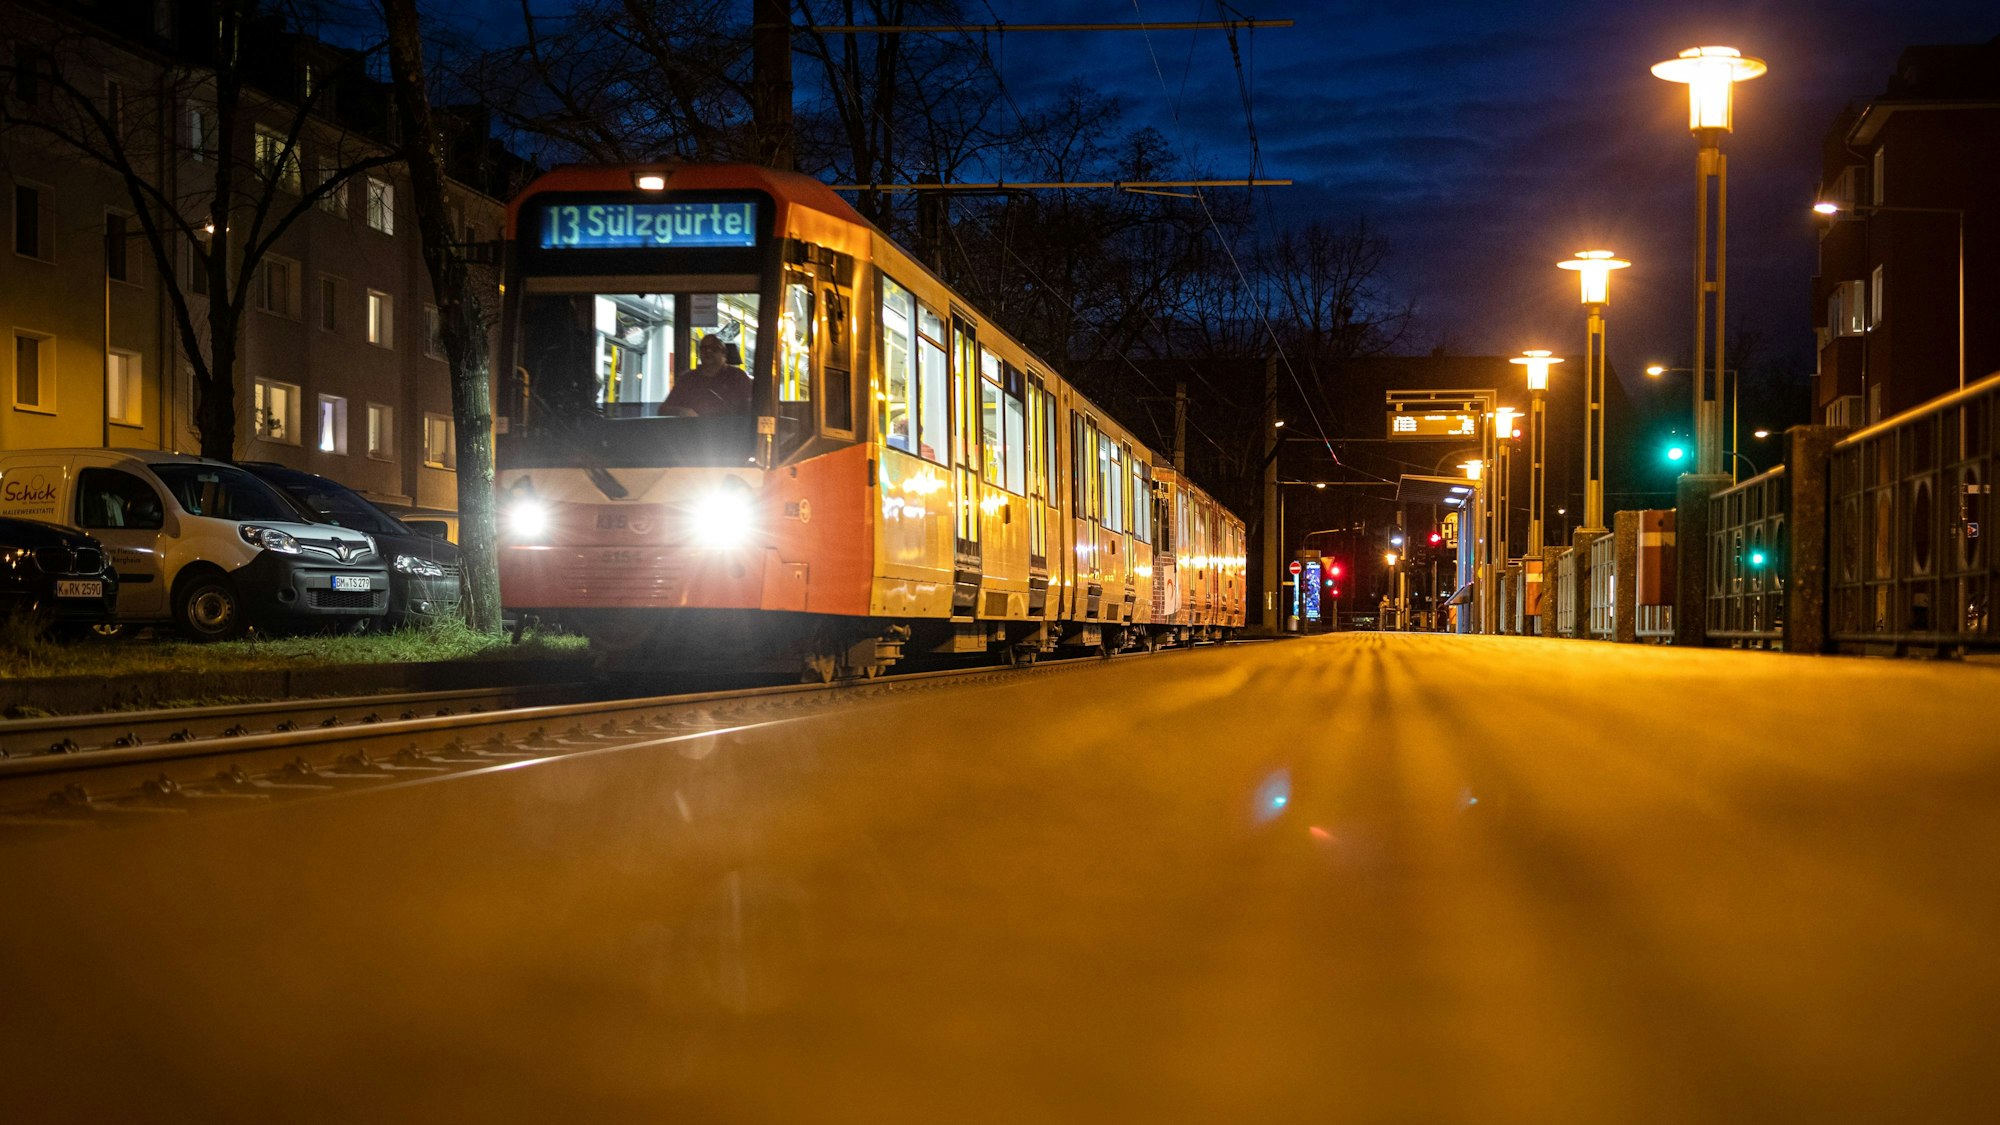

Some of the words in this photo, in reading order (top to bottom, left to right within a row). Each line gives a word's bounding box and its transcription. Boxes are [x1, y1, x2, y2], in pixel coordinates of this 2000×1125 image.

[550, 207, 580, 245] 13
[587, 205, 751, 243] Sülzgürtel
[5, 481, 56, 501] Schick
[1441, 523, 1453, 539] H
[59, 583, 64, 595] K
[69, 583, 80, 595] RK
[82, 583, 101, 595] 2590
[336, 578, 345, 587] BM
[349, 578, 357, 587] TS
[358, 579, 369, 588] 279
